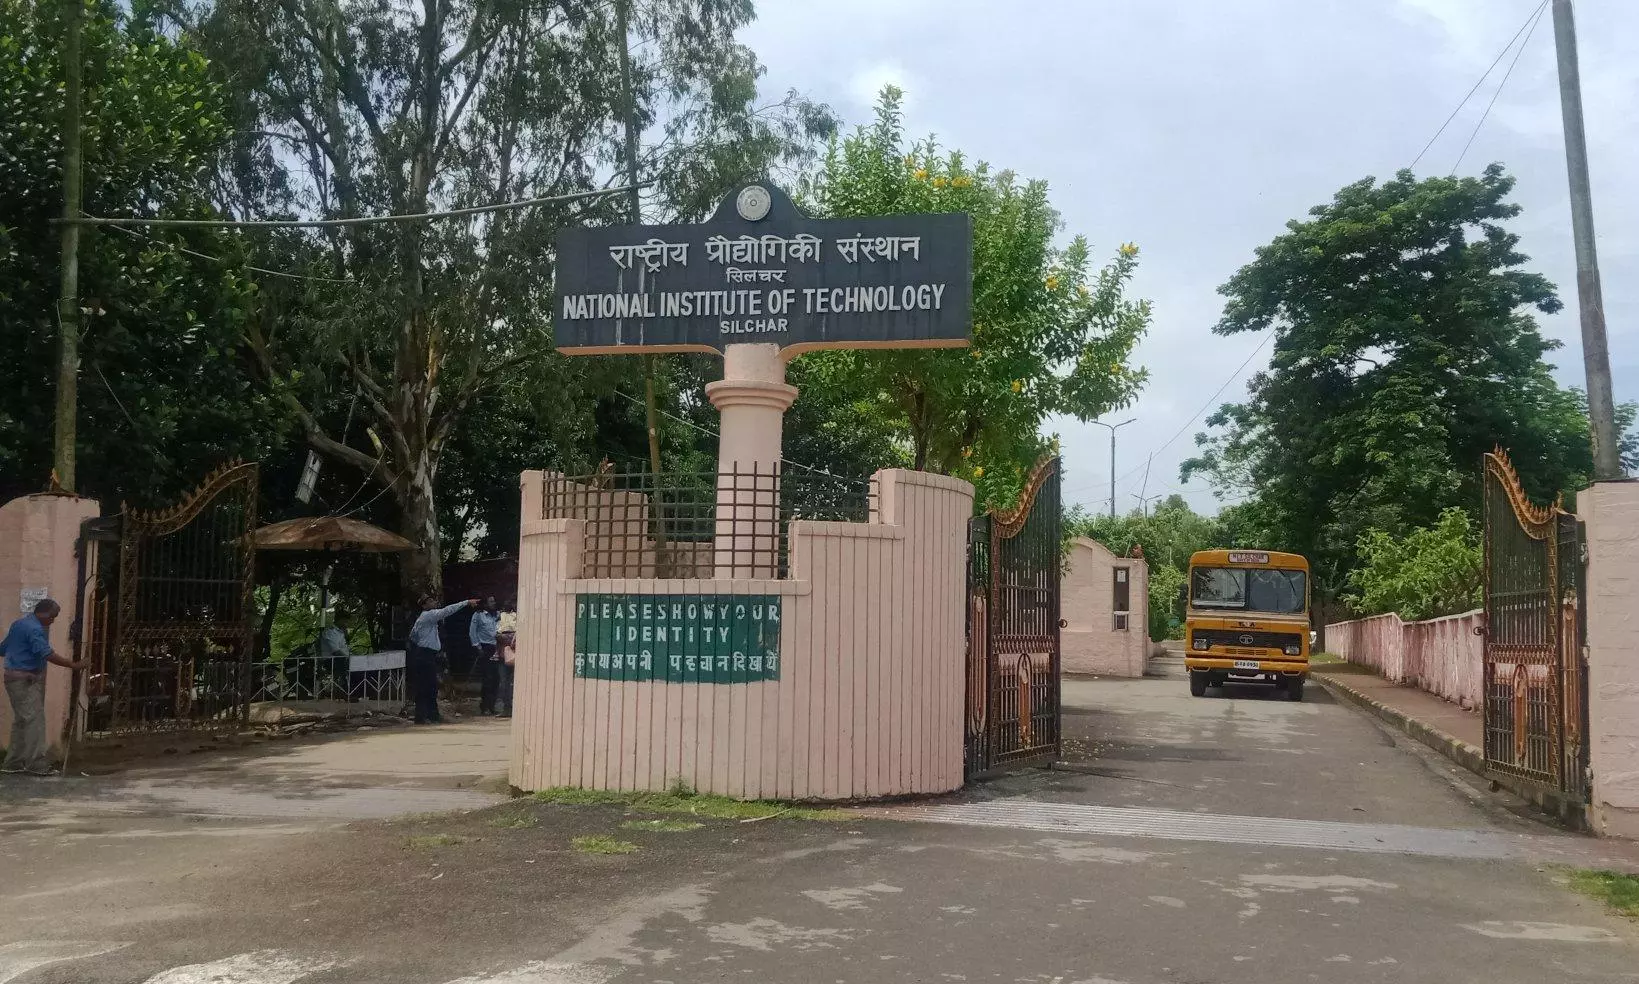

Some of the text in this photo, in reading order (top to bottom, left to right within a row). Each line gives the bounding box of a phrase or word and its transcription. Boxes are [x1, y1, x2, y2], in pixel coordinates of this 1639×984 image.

[609, 238, 690, 273] राष्ट्रीय
[836, 232, 921, 263] संस्थान
[726, 267, 787, 283] सिलचर
[562, 283, 946, 320] NATIONAL INSTITUTE OF TECHNOLOGY
[720, 318, 788, 335] SILCHAR
[578, 603, 780, 621] PLEASE SHOW YOUR
[615, 626, 730, 643] IDENTITY
